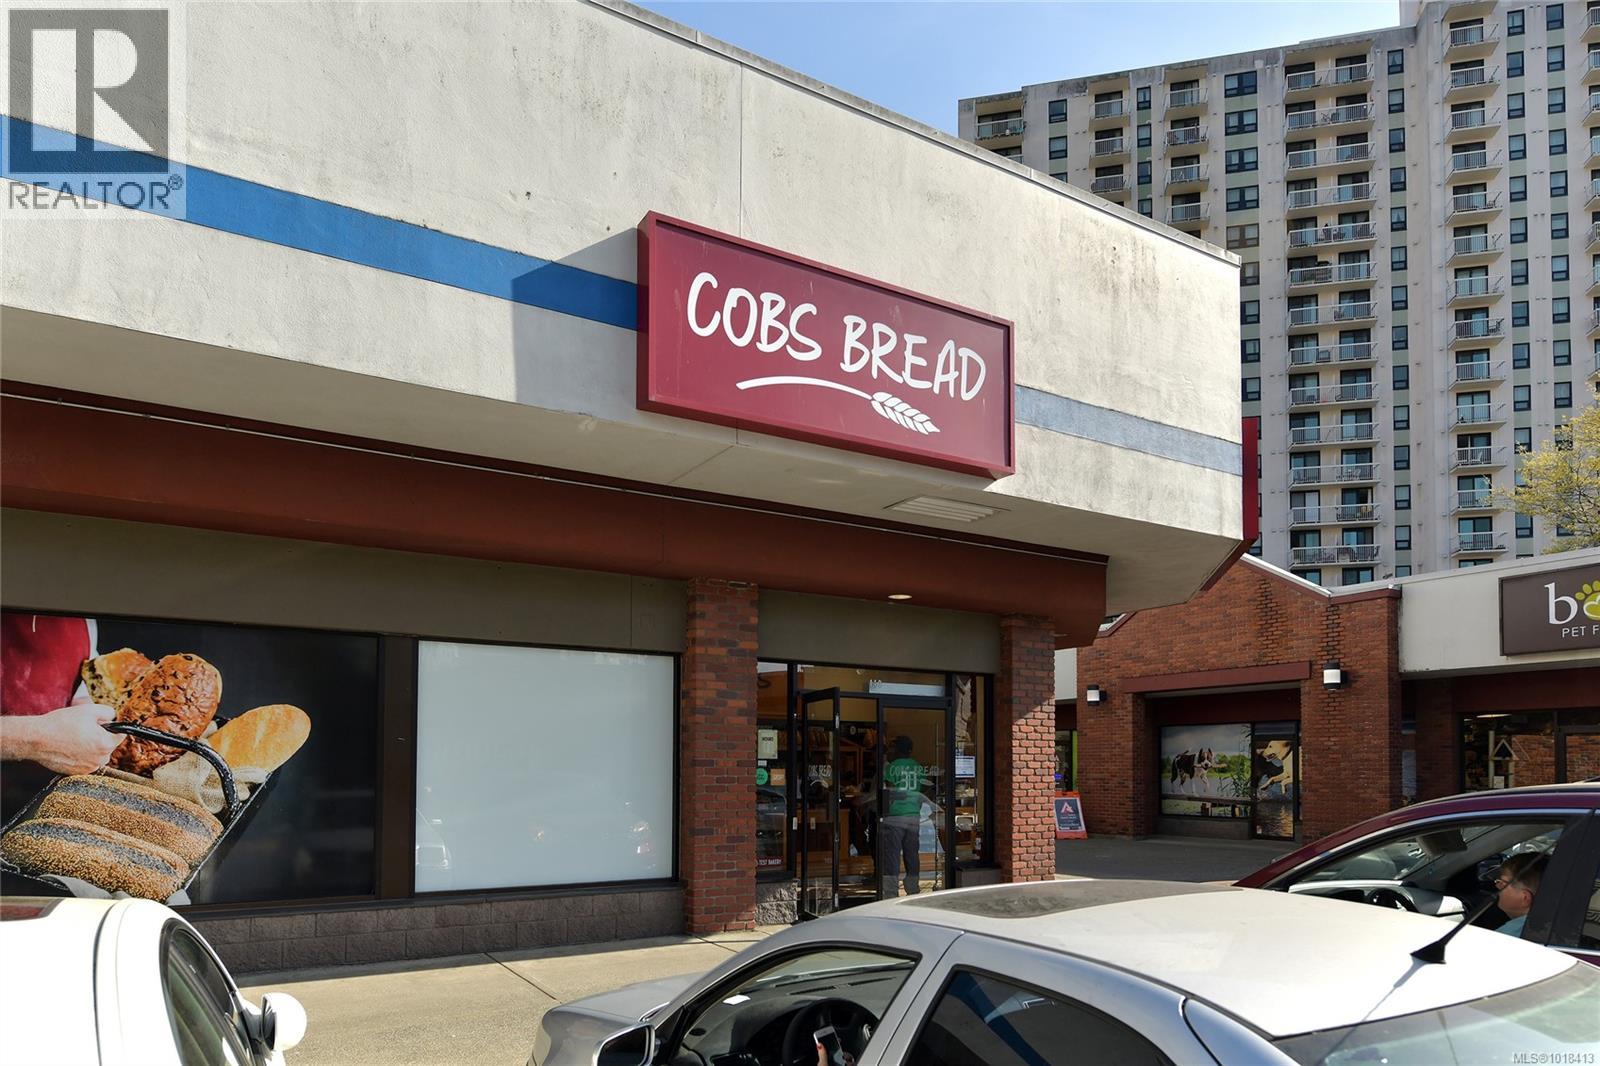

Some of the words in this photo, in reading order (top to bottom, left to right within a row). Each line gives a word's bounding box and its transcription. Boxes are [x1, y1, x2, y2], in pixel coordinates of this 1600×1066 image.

[687, 272, 823, 361] COBS
[839, 315, 987, 401] BREAD
[1562, 626, 1587, 638] PET
